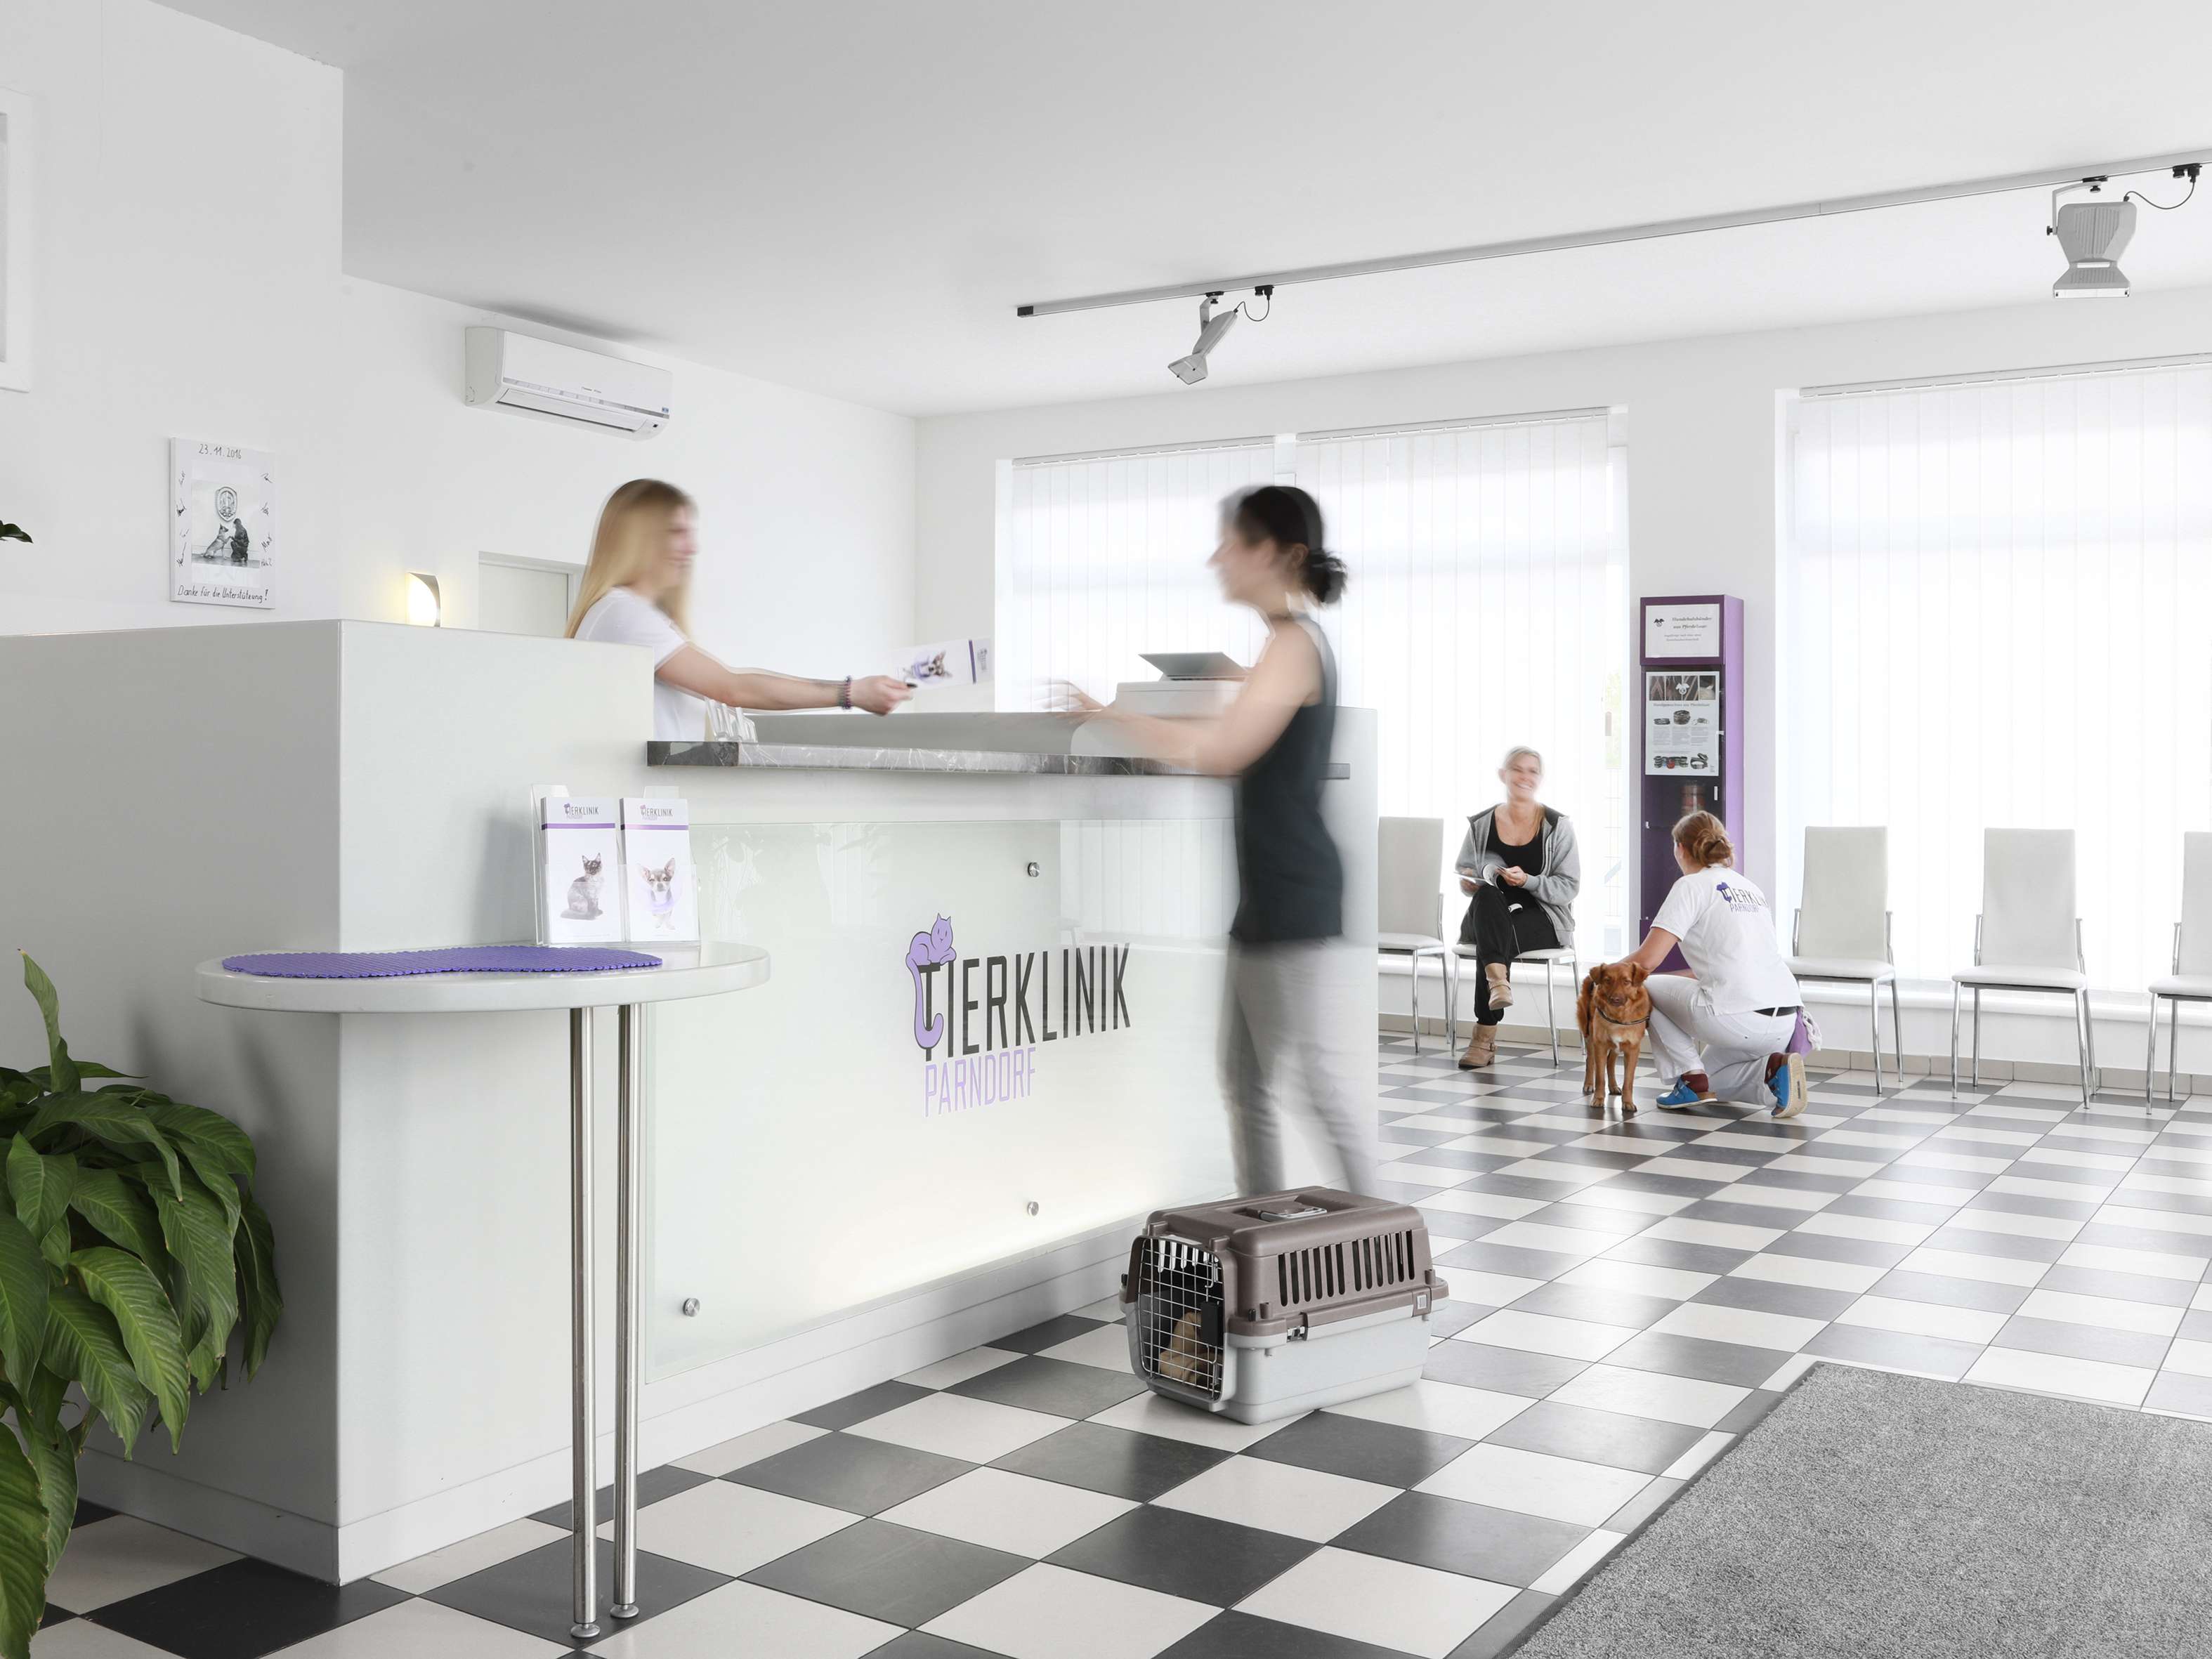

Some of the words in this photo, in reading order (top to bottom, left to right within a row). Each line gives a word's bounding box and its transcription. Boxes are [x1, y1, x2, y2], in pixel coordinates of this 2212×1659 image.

[178, 585, 197, 596] Danke
[200, 586, 210, 597] für
[565, 806, 599, 815] TIERKLINIK
[641, 808, 674, 817] TIERKLINIK
[916, 943, 1130, 1061] TIERKLINIK
[924, 1047, 1036, 1117] PARNDORF
